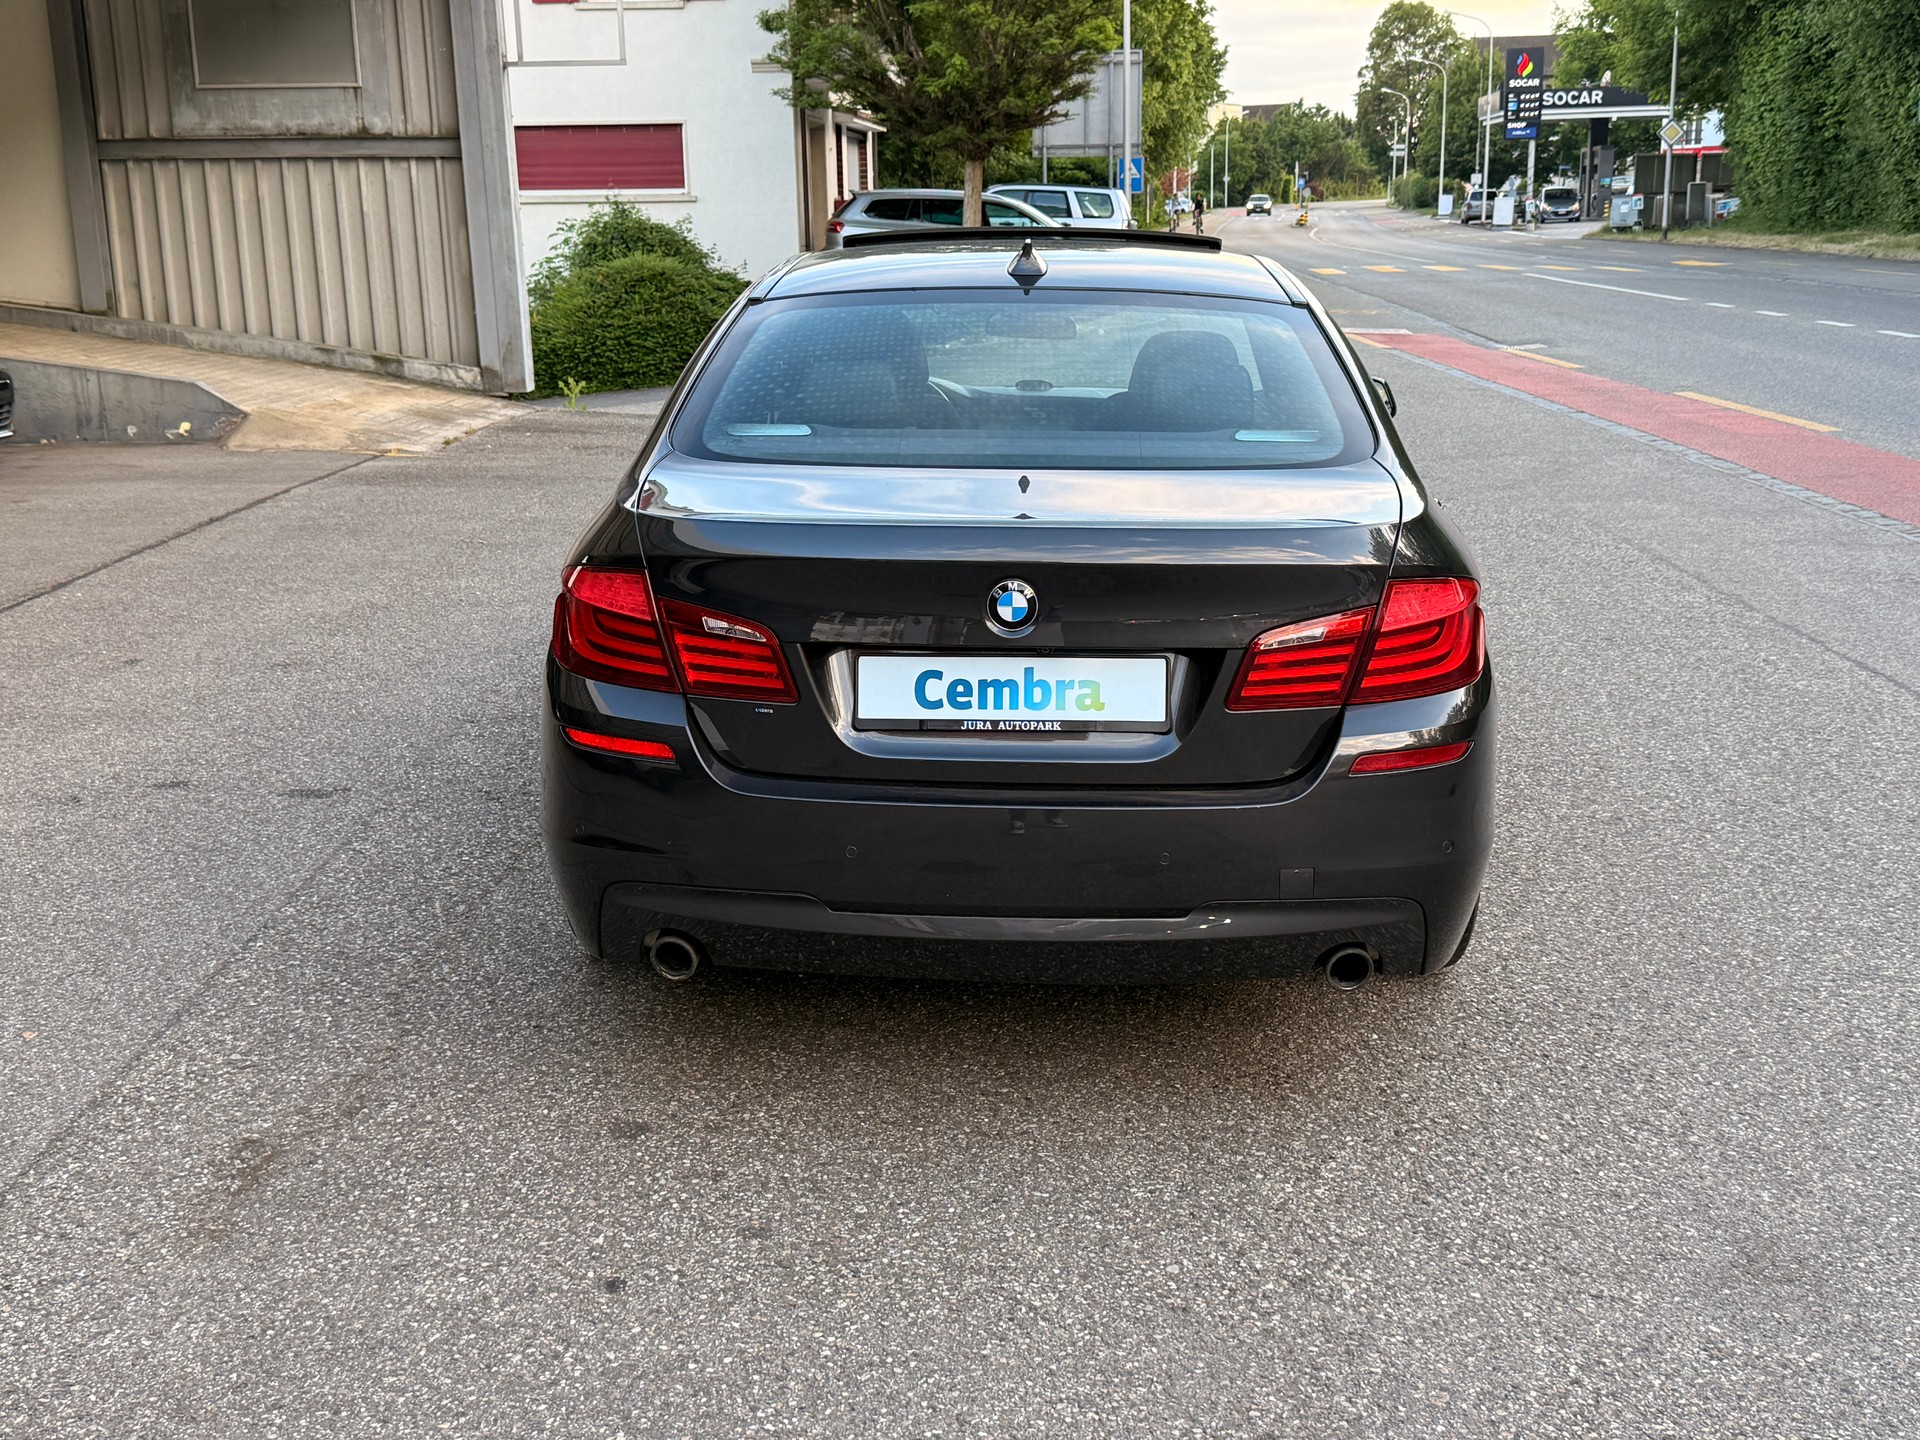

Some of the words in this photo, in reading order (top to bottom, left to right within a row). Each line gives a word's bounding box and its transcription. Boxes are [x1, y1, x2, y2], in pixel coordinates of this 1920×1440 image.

[1509, 78, 1540, 88] SOCAR
[1542, 90, 1604, 106] SOCAR
[1507, 121, 1527, 129] SHOP
[993, 582, 1034, 599] BMW
[914, 666, 1106, 712] Cembra
[961, 720, 992, 730] JURA
[998, 721, 1062, 731] AUTOPARK
